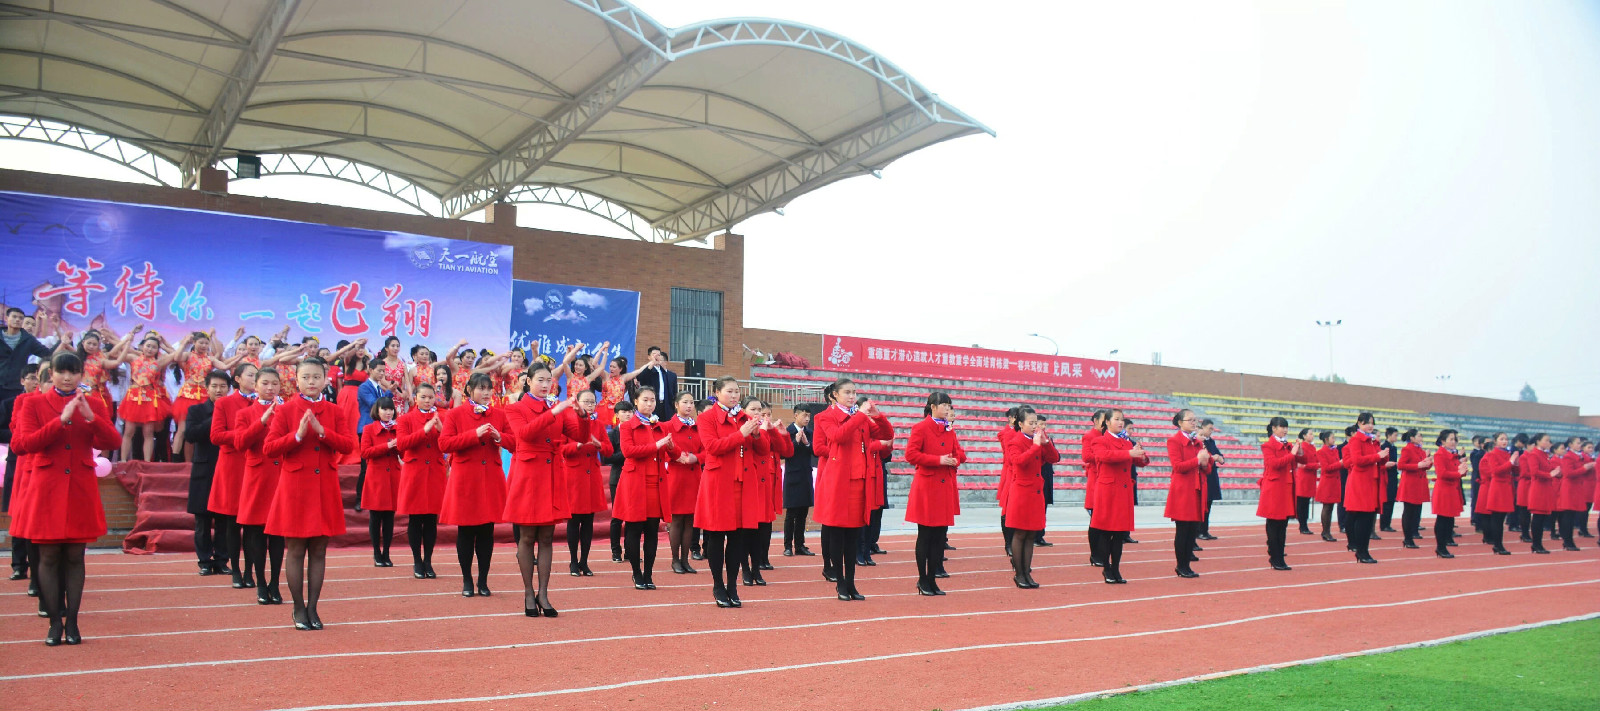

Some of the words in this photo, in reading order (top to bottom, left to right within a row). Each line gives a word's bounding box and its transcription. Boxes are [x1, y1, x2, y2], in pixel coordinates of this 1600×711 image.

[438, 247, 498, 267] 天一航空
[438, 263, 456, 271] TIAN
[465, 266, 499, 275] AVIATION
